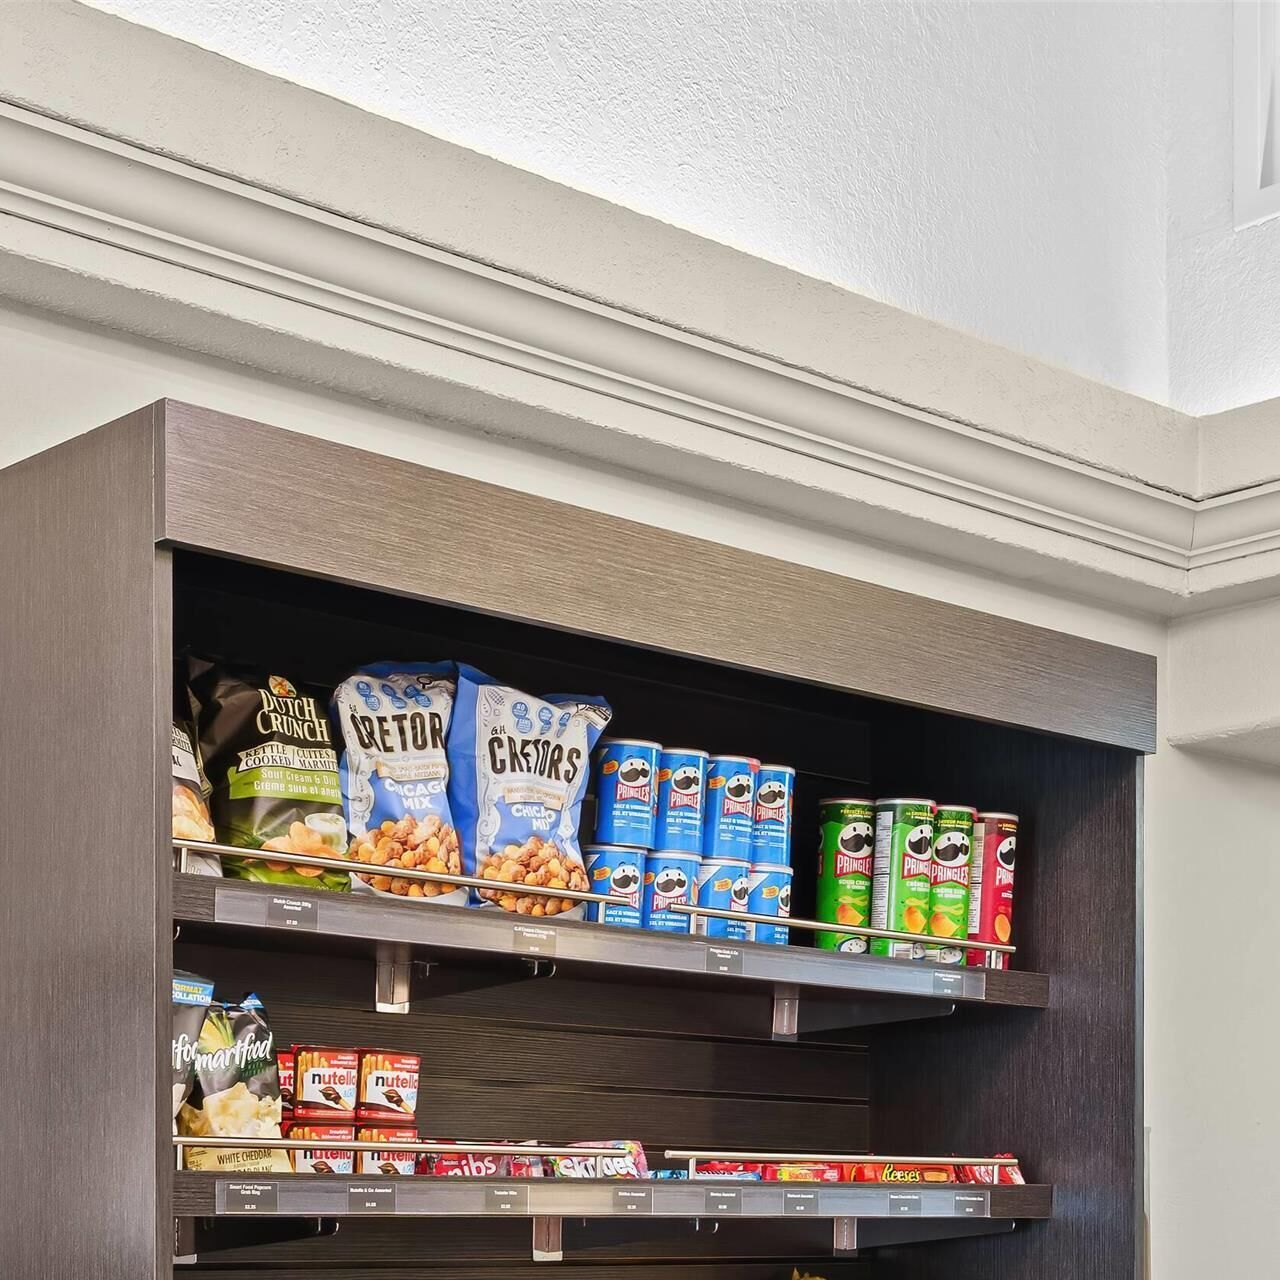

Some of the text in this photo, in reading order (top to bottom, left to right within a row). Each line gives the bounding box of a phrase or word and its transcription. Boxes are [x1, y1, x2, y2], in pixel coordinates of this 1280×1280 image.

[258, 689, 316, 721] DUTCH
[256, 709, 330, 742] CRUNCH
[245, 744, 288, 758] KETTLE
[297, 750, 330, 760] CUITES
[488, 736, 581, 784] CRETORS
[245, 755, 291, 768] COOKED
[617, 783, 650, 803] PRINGLES
[402, 797, 433, 810] MIX
[931, 863, 969, 886] PRINGLES
[194, 1032, 273, 1072] martfood
[217, 1148, 273, 1165] WHITE CHEDDAR
